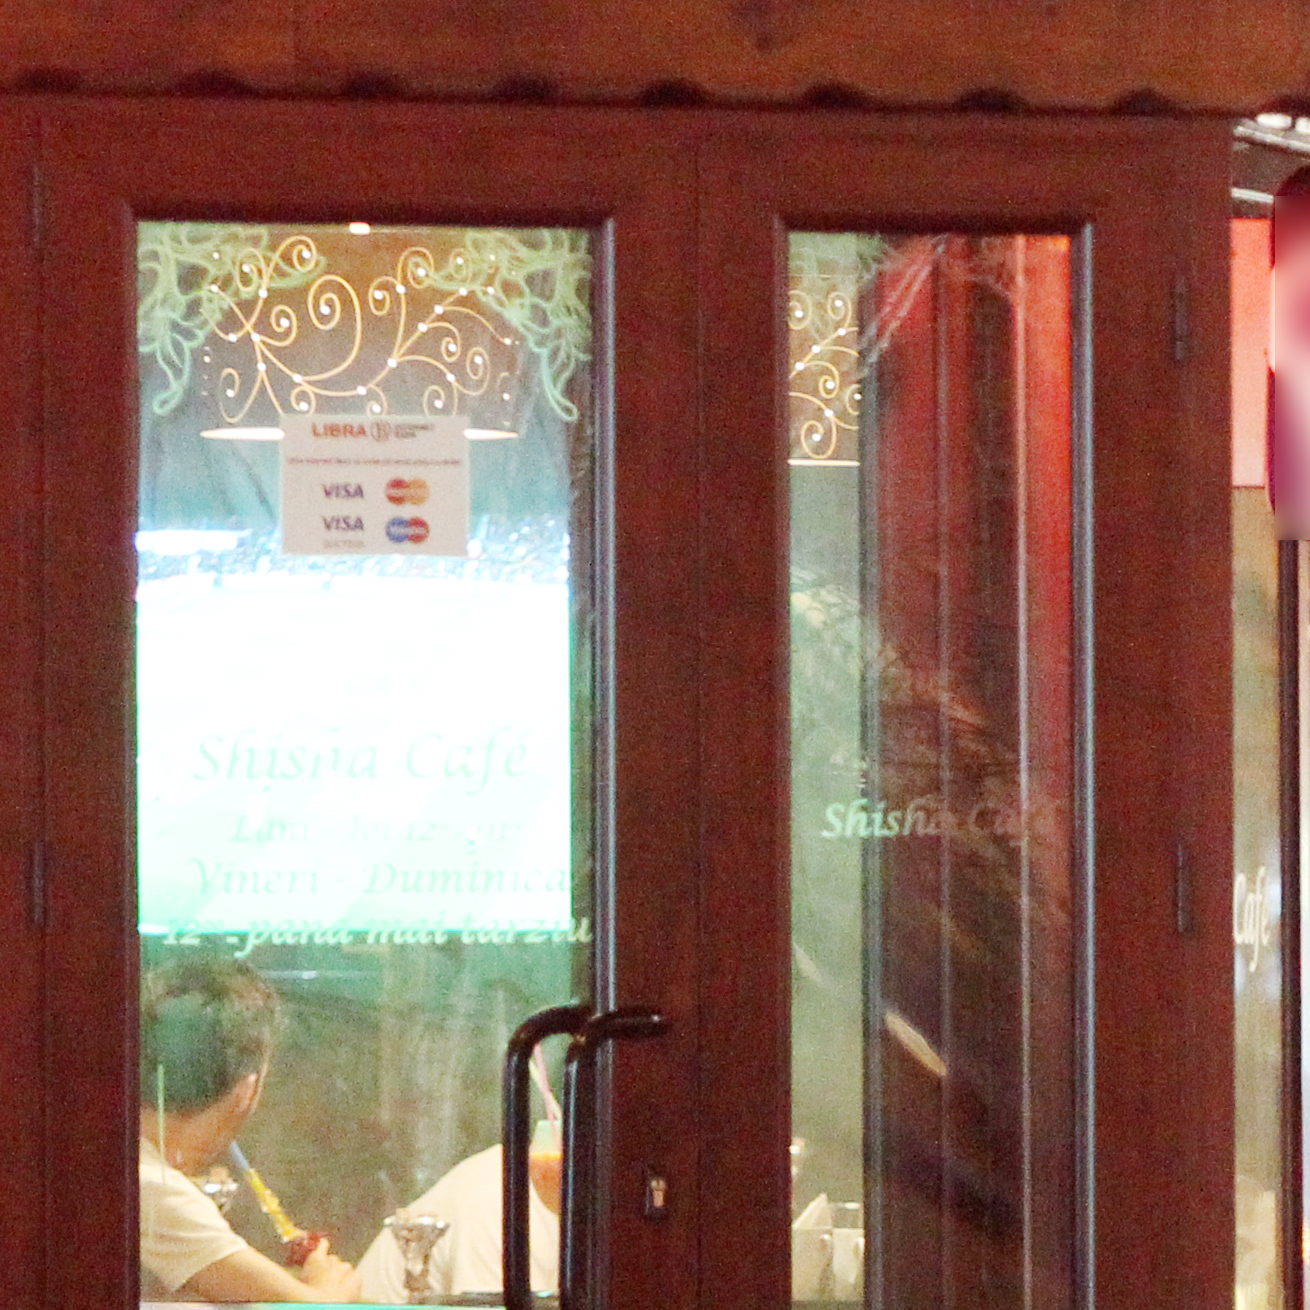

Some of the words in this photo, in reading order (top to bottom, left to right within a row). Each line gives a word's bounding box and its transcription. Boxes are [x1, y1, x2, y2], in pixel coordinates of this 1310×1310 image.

[312, 422, 367, 438] LIBRA
[322, 482, 365, 499] VISA
[321, 515, 365, 532] VISA
[193, 727, 379, 781] Shisha
[404, 724, 531, 797] Café
[185, 857, 321, 896] Vineri
[366, 908, 449, 945] mai
